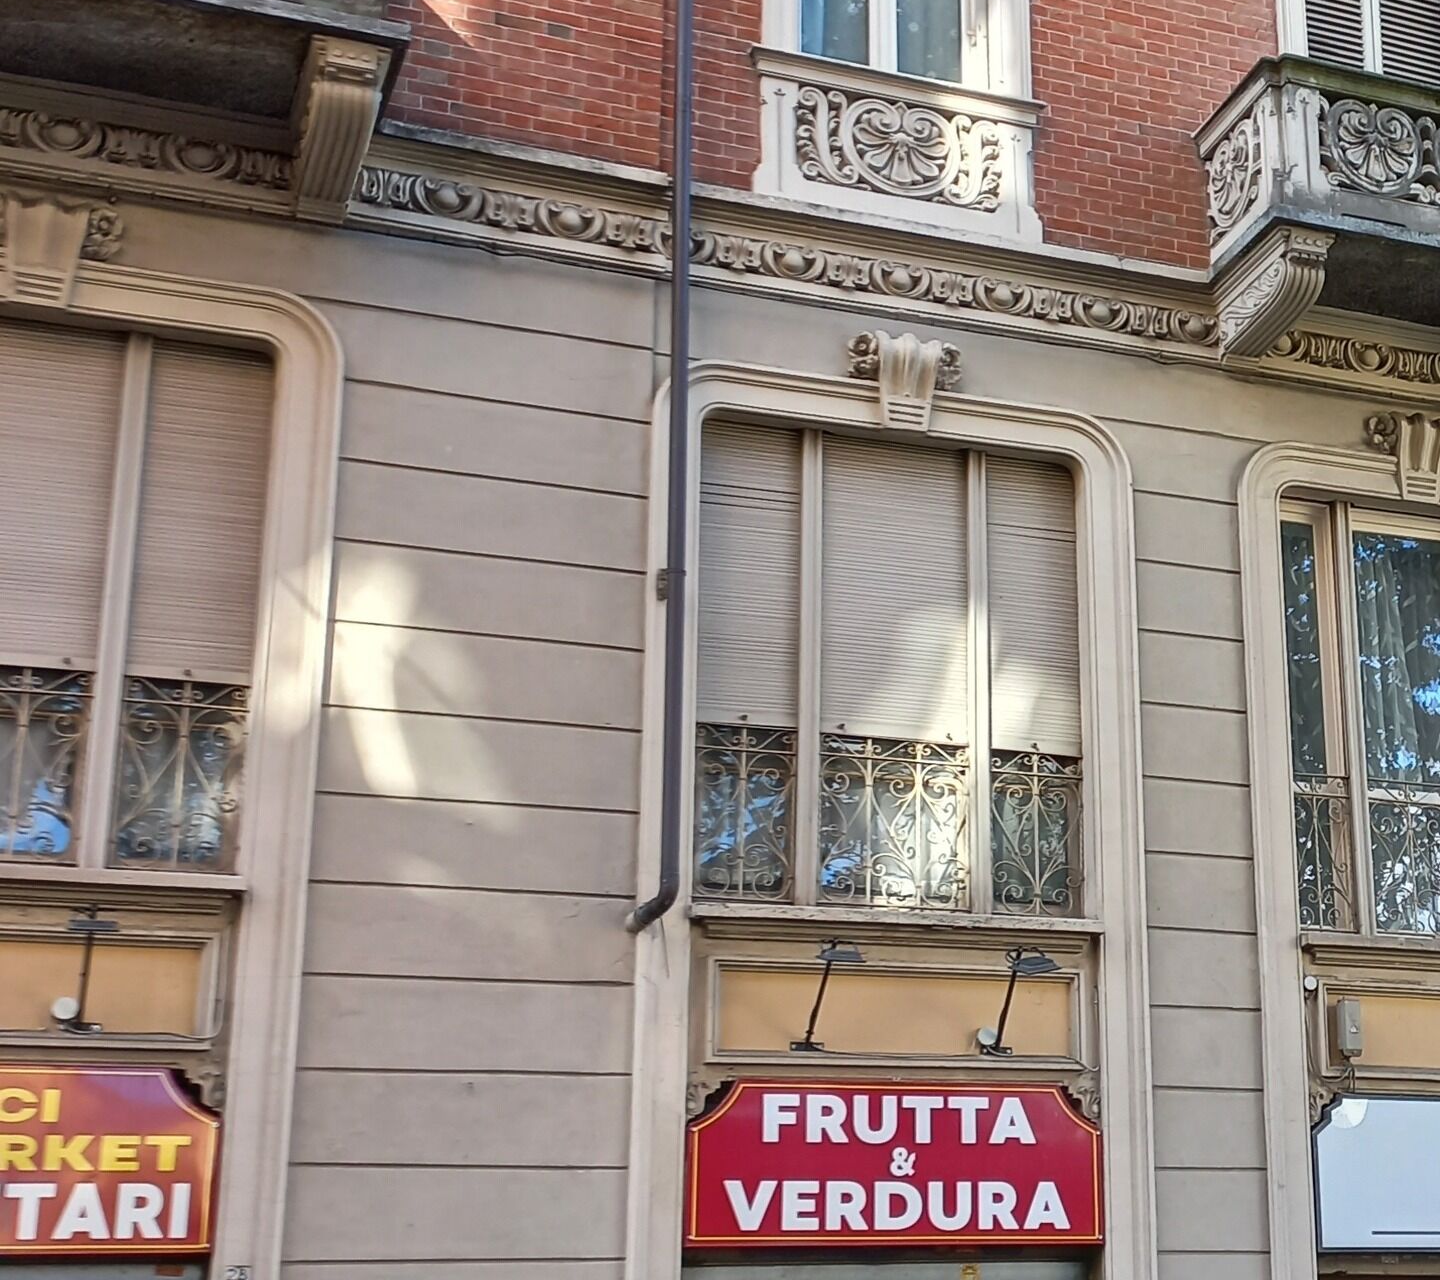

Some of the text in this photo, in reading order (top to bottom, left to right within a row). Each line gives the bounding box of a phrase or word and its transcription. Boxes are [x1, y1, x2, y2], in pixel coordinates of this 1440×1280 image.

[761, 1093, 1037, 1145] FRUTTA
[888, 1146, 916, 1177] &
[722, 1180, 1072, 1232] VERDURA
